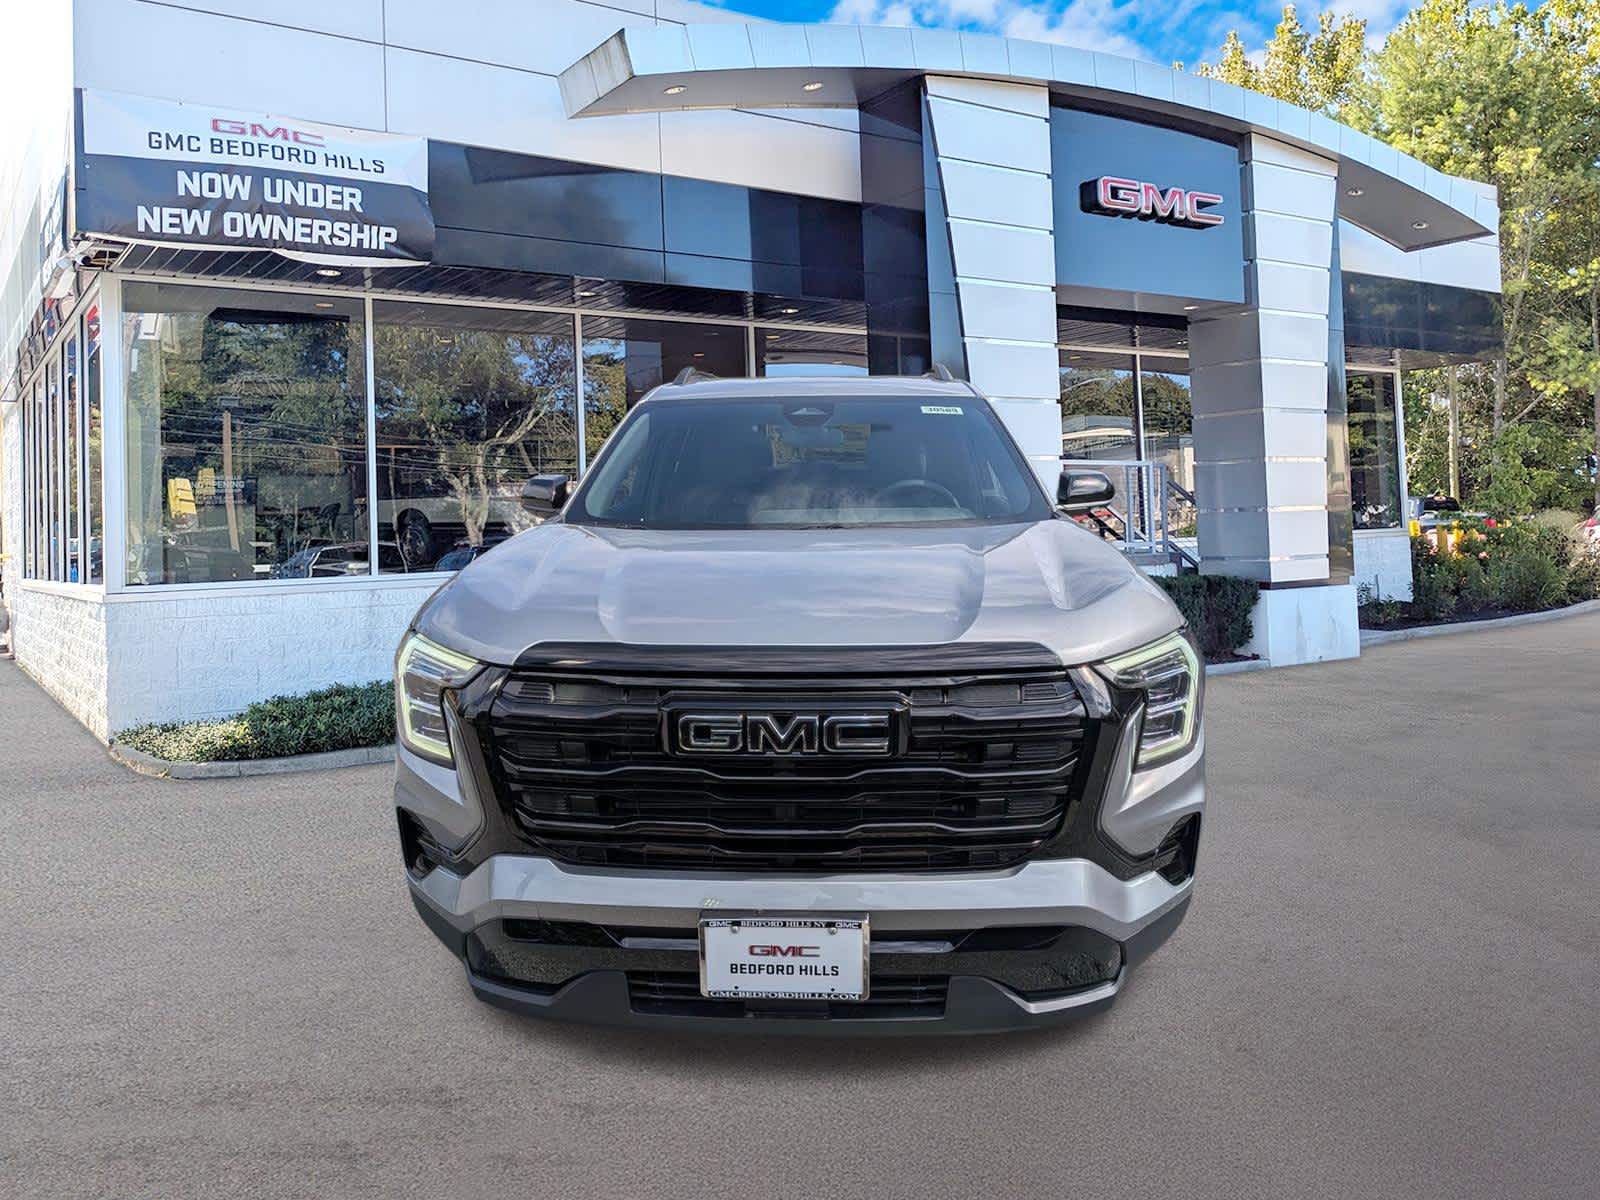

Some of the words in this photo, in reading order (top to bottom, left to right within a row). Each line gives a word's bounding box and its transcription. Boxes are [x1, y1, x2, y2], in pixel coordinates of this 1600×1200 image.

[211, 118, 326, 148] GMC
[148, 131, 200, 154] GMC
[210, 138, 317, 166] BEDFORD
[324, 152, 386, 174] HILLS
[176, 170, 252, 201] NOW
[264, 177, 362, 212] UNDER
[1097, 175, 1225, 225] GMC
[136, 205, 212, 237] NEW
[223, 211, 398, 251] OWNERSHIP
[678, 714, 889, 753] GMC
[740, 920, 784, 929] BEDFORD
[785, 920, 812, 929] HILLS
[814, 920, 827, 929] NY
[834, 922, 860, 930] GMC
[748, 944, 821, 958] GMC
[729, 963, 795, 976] BEDFORD
[799, 965, 840, 977] HILLS
[710, 990, 860, 1001] GMCBEDFORDHILLS.COM
